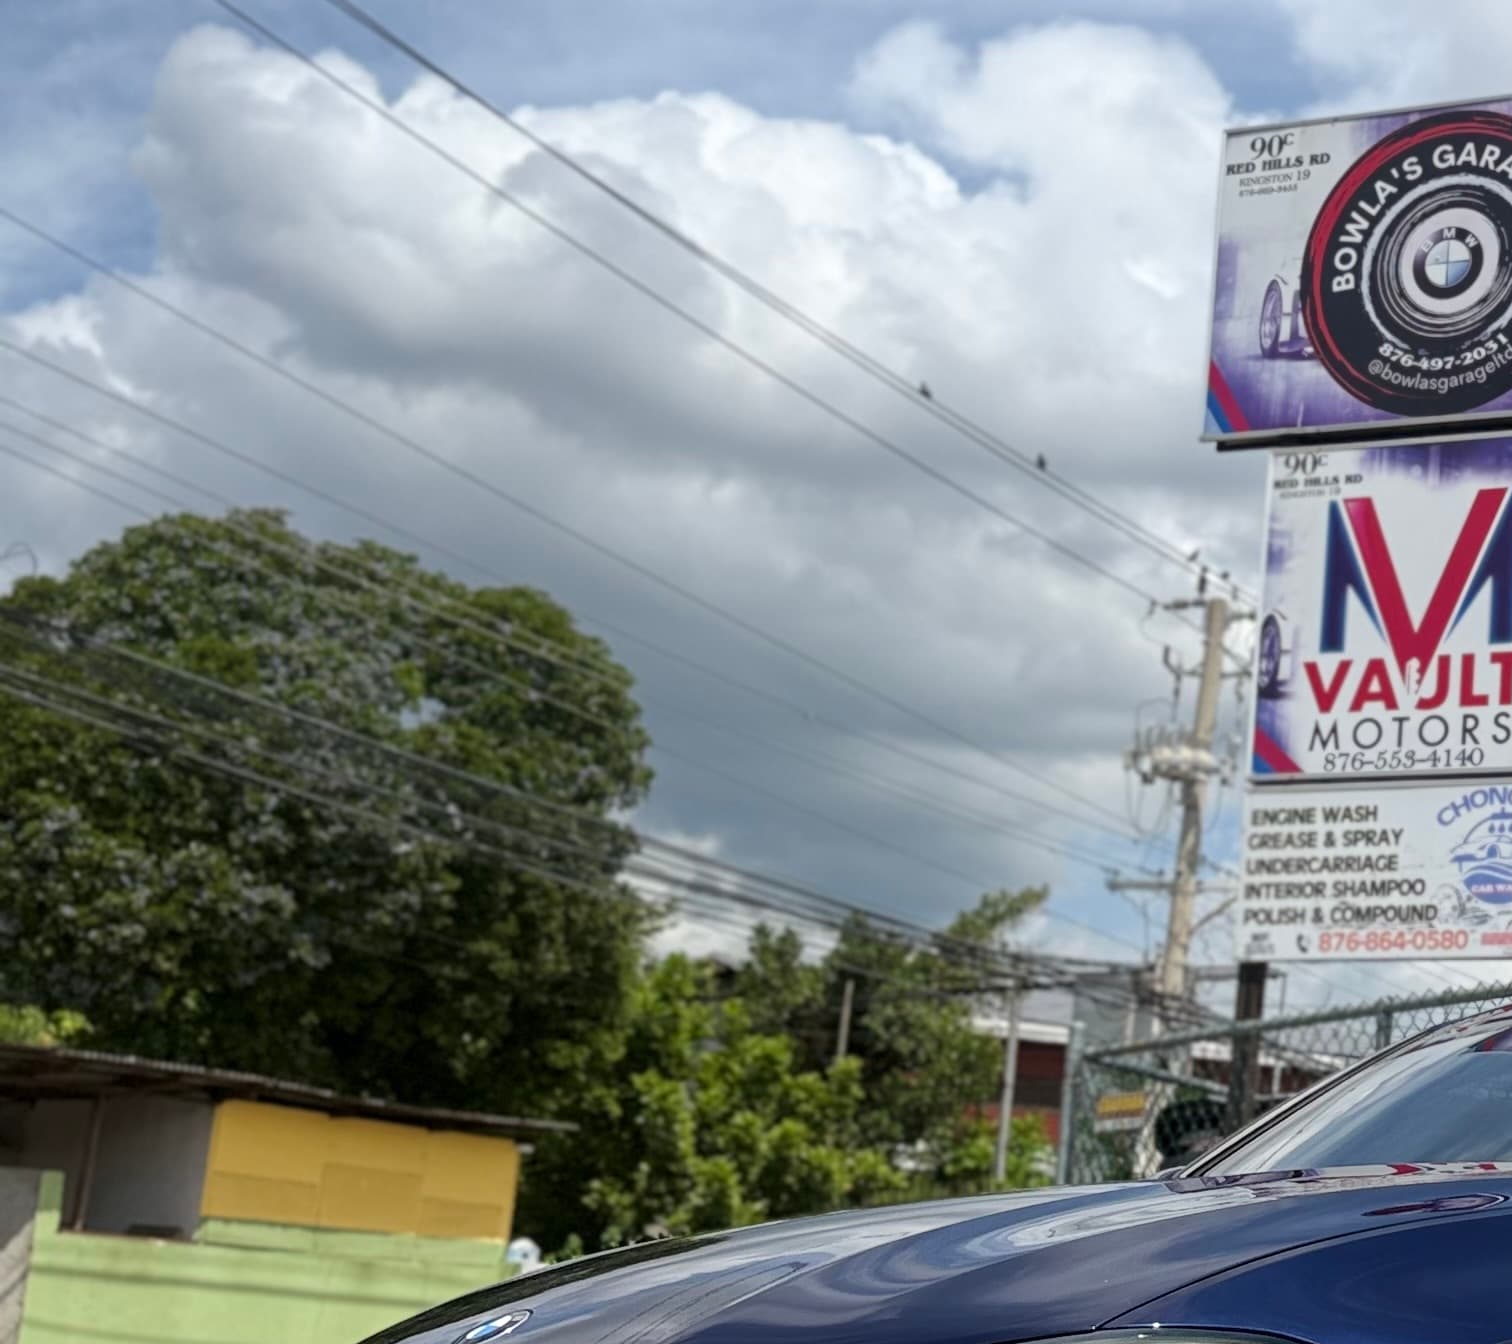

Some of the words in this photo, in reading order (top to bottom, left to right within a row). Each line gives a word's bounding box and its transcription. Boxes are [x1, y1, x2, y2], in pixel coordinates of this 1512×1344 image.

[1226, 162, 1256, 176] RED
[1262, 155, 1304, 171] HILLS
[1309, 152, 1331, 166] RD
[1296, 169, 1311, 181] 19
[1332, 155, 1424, 294] BOWLA'S
[1378, 333, 1509, 371] 876-497-2031
[1308, 711, 1512, 752] MOTORS
[1323, 747, 1485, 772] 876-553-4140
[1251, 807, 1316, 827] ENGINE
[1322, 805, 1378, 823] WASH
[1248, 830, 1320, 851] GREASE
[1326, 830, 1336, 847] &
[1343, 828, 1404, 848] SPRAY
[1246, 854, 1399, 876] UNDERCARRIAGE
[1245, 880, 1327, 901] INTERIOR
[1333, 878, 1426, 897] SHAMPOO
[1244, 907, 1306, 926] POLISH
[1312, 907, 1323, 924] &
[1330, 904, 1438, 923] COMPOUND
[1318, 929, 1469, 952] 876-864-0580
